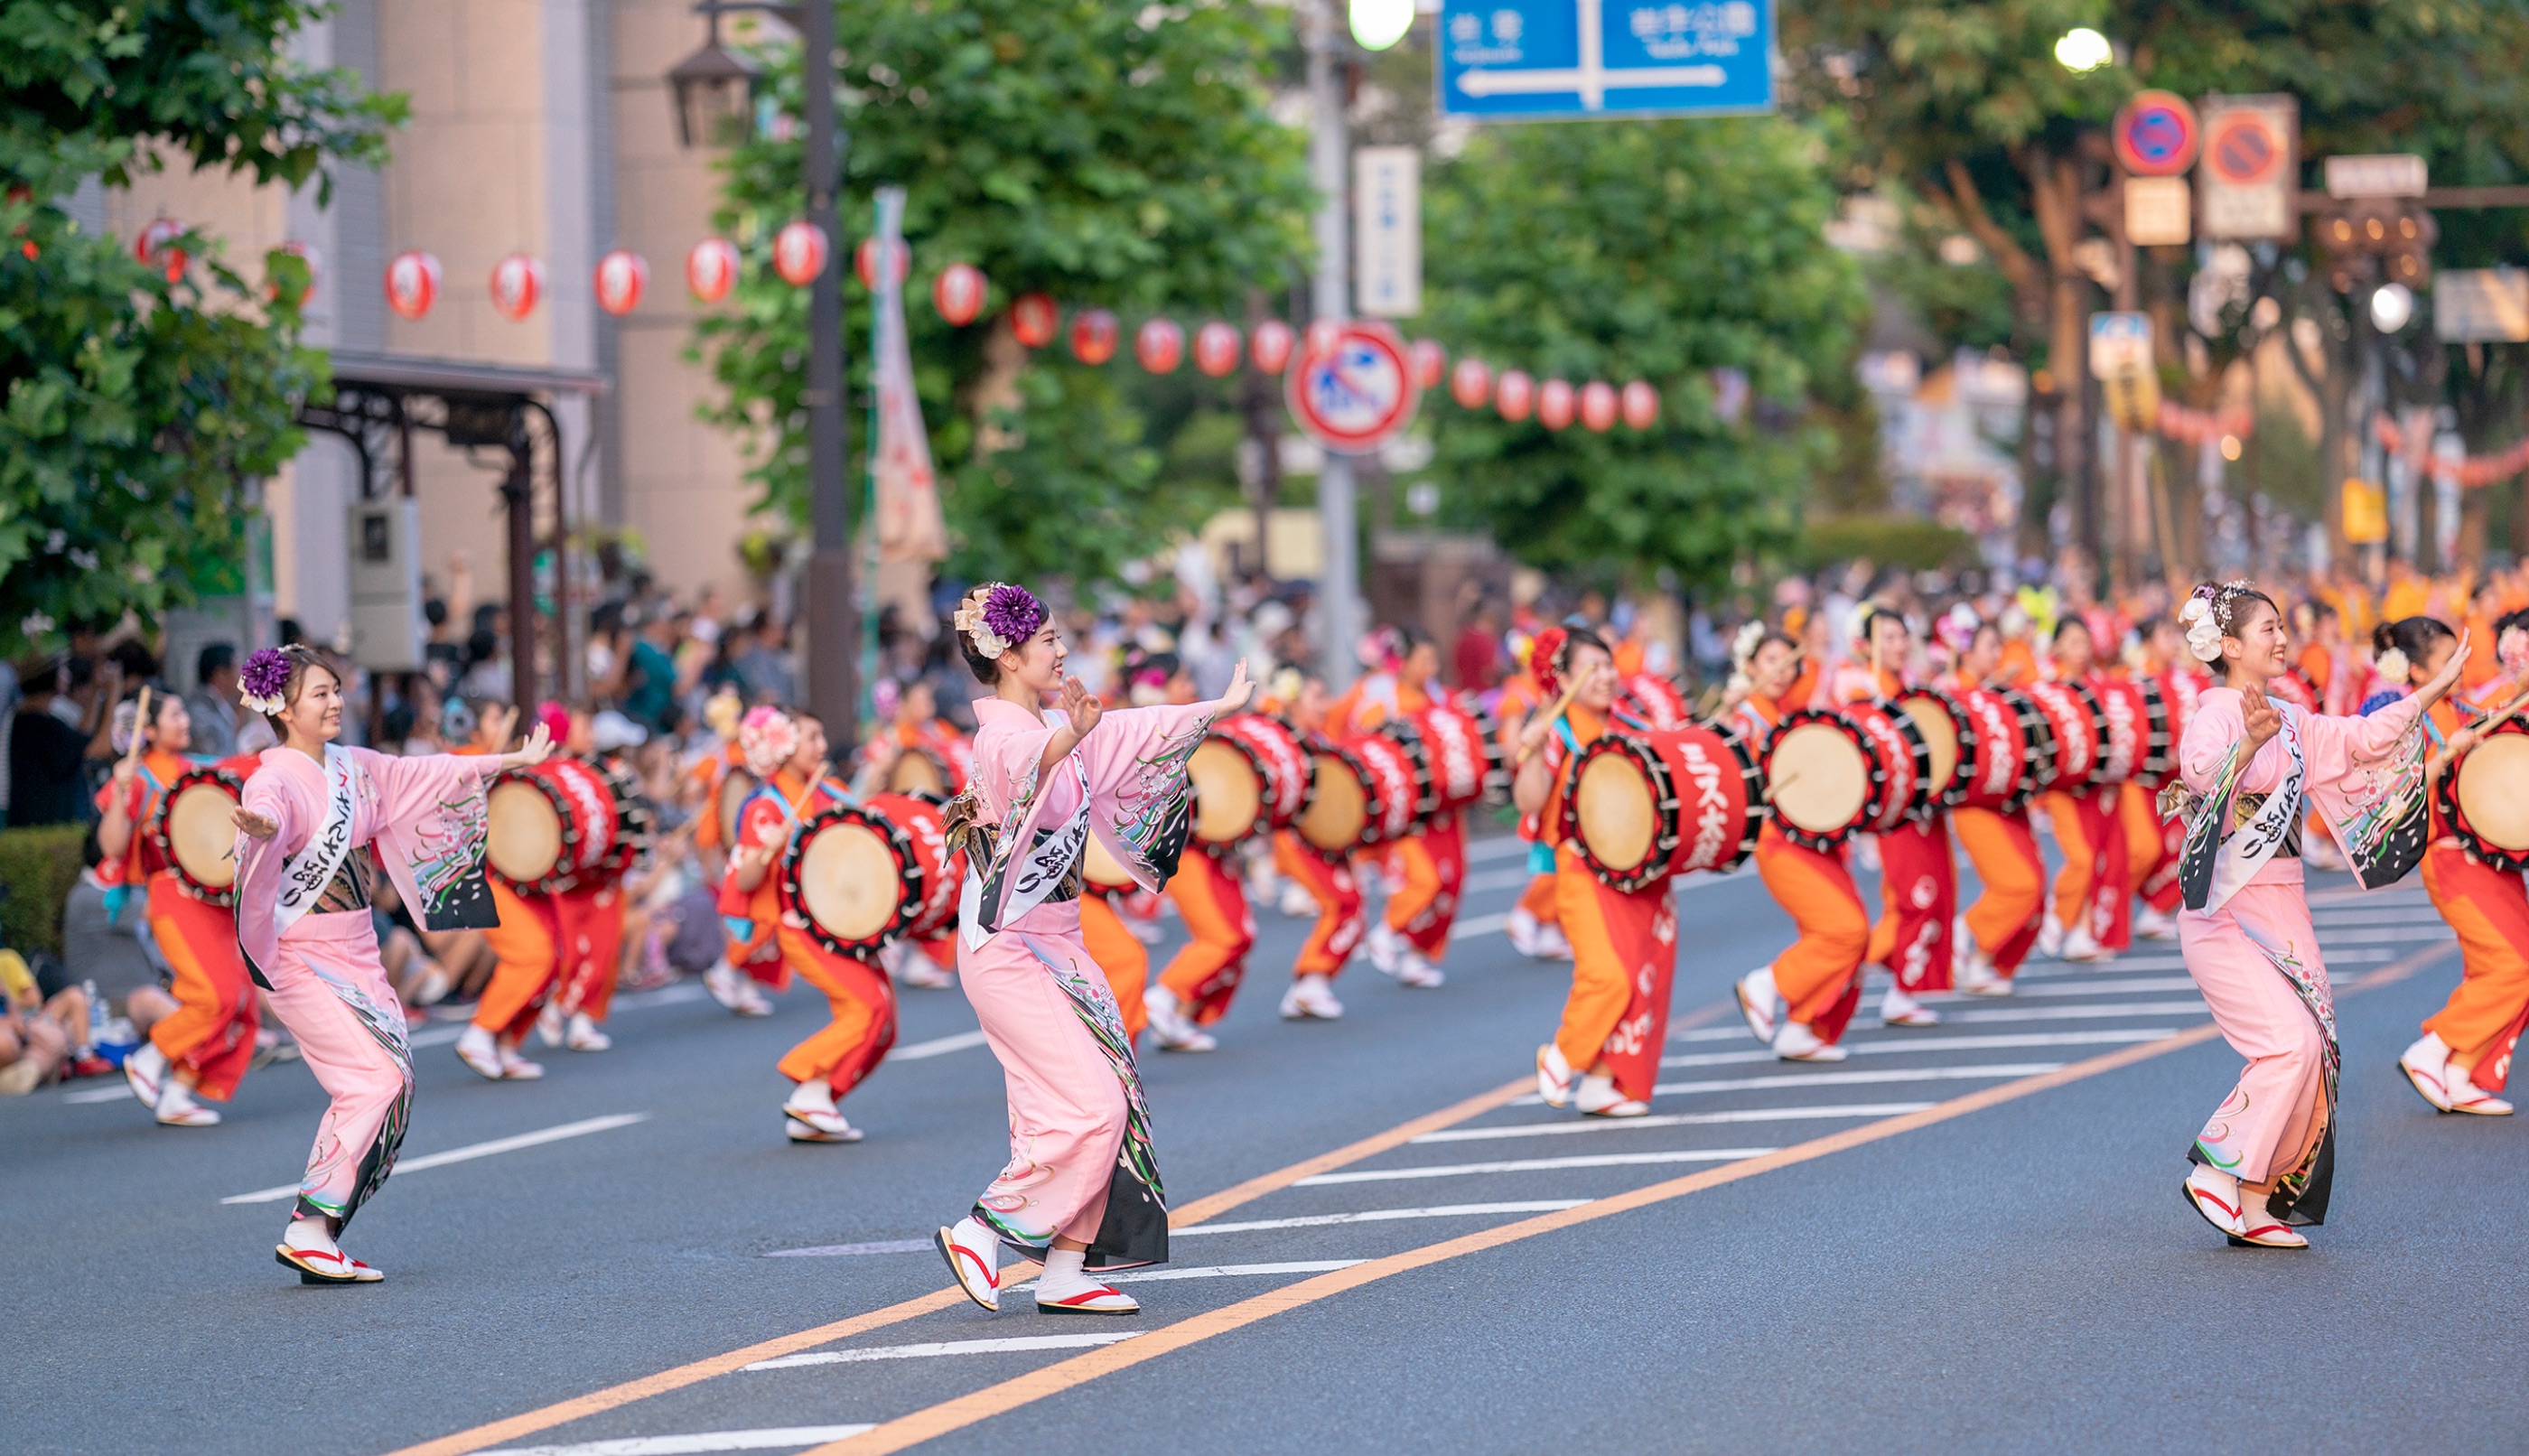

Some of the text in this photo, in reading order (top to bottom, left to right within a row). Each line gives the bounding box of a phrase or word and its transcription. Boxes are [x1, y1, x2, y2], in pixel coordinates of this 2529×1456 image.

[281, 756, 351, 907] ミスさんさ踊り
